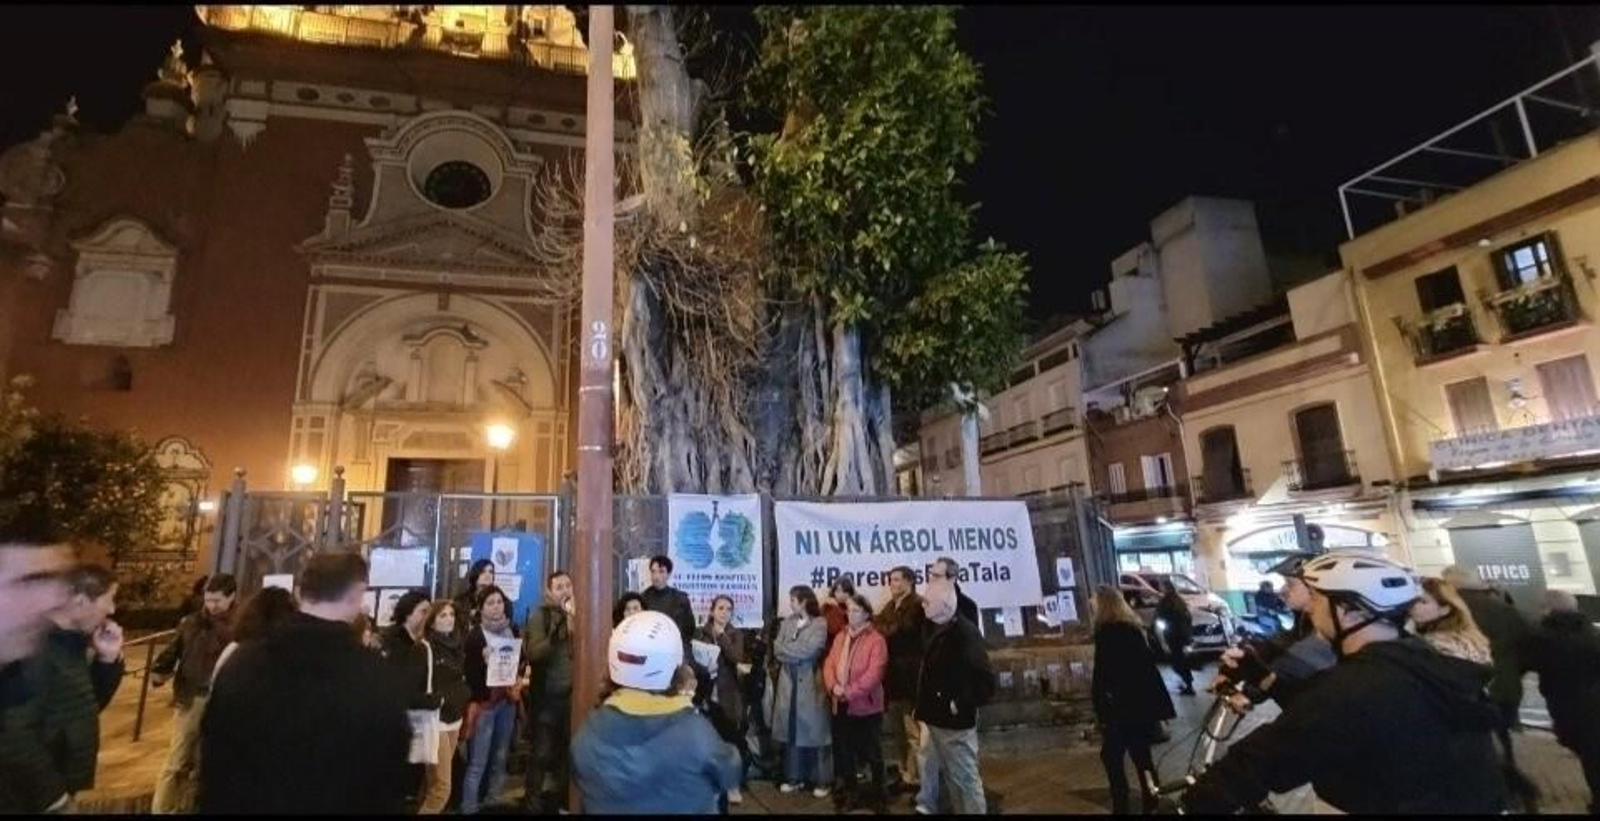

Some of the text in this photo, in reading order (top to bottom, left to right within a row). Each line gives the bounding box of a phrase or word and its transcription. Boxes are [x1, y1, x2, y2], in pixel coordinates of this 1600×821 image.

[591, 320, 607, 360] 20
[795, 524, 1018, 555] NI UN ÁRBOL MENOS
[1478, 564, 1530, 579] TIPICO
